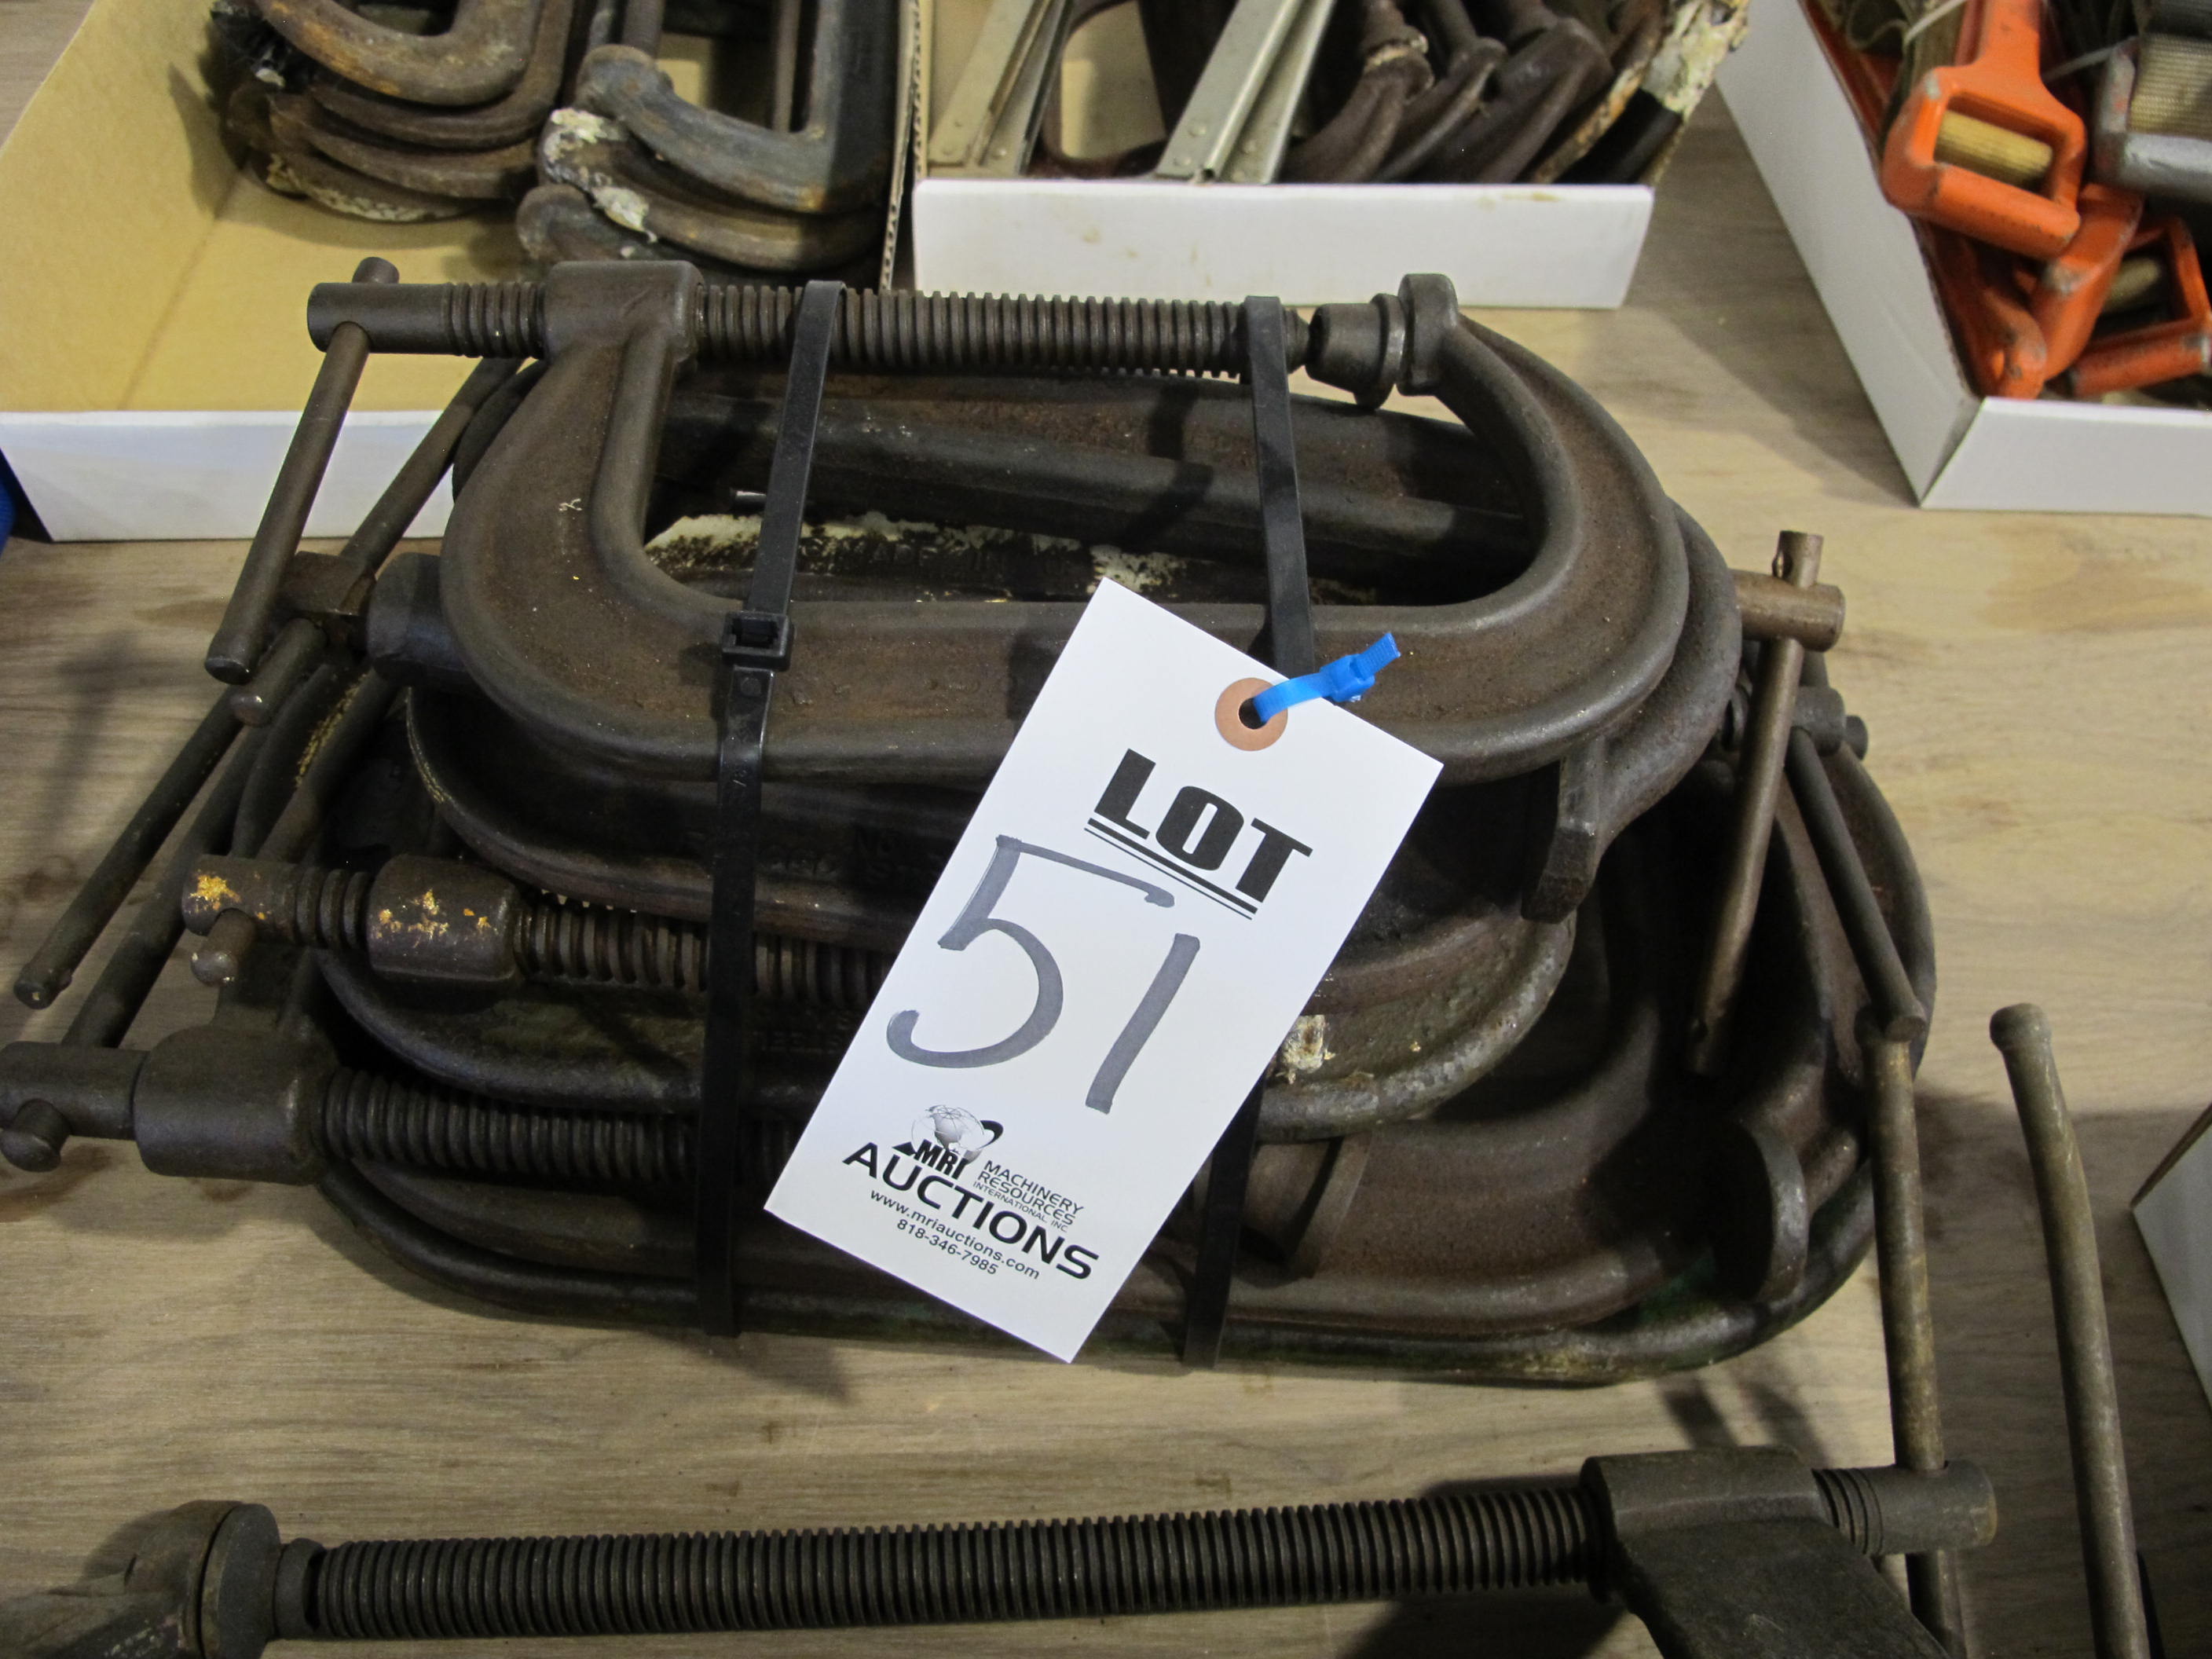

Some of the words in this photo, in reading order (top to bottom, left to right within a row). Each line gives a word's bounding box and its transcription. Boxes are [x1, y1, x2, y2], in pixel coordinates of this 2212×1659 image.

[1093, 748, 1313, 903] LOT
[912, 1138, 970, 1181] MRI
[983, 1159, 1084, 1215] MACHINERY
[841, 1141, 1100, 1280] AUCTIONS
[977, 1170, 1075, 1226] RESOURCES
[870, 1189, 1040, 1280] www.mriauctions.com
[896, 1218, 999, 1275] 818-346-7985
